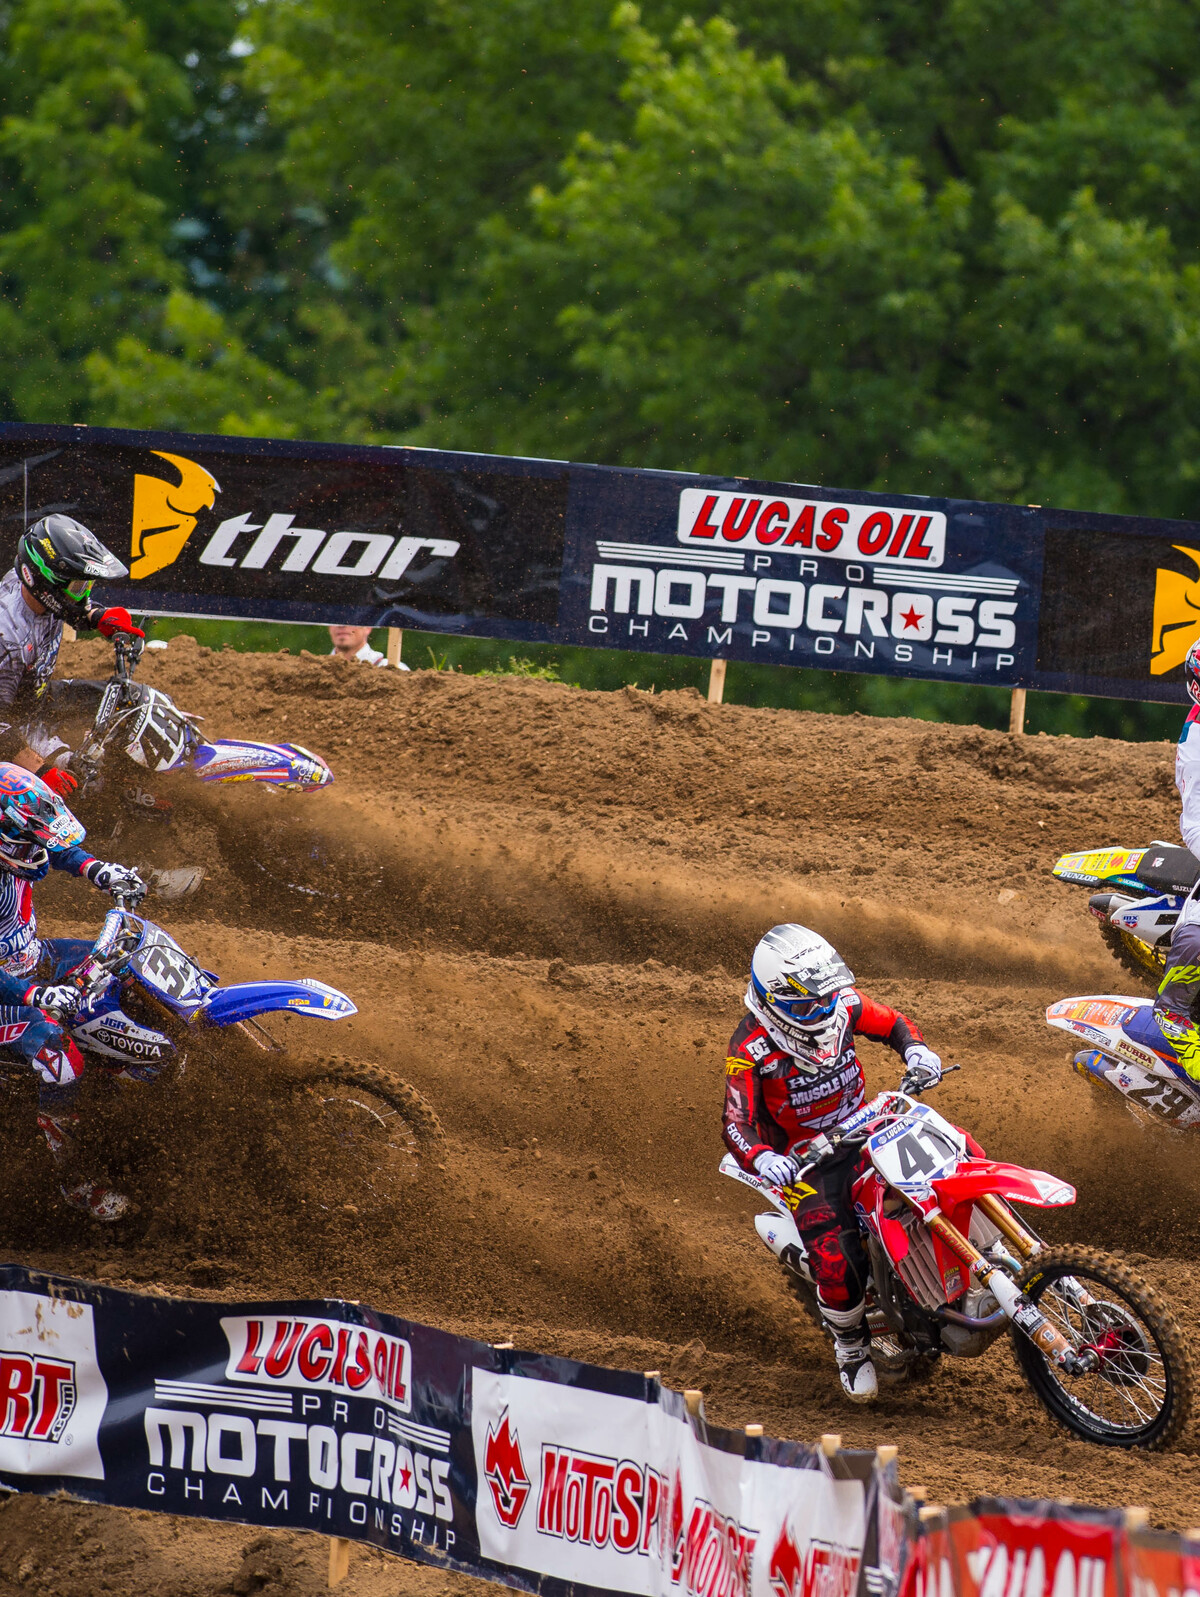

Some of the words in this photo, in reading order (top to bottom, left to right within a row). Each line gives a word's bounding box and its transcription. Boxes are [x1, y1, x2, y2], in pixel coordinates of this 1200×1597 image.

[690, 495, 849, 552] LUCAS
[857, 511, 934, 561] OIL
[200, 511, 460, 580] thor
[752, 555, 864, 583] PRO
[590, 563, 1018, 649] MOTOCROSS
[588, 616, 1015, 671] CHAMPIONSHIP
[1060, 871, 1098, 882] DUNLOP
[1172, 884, 1195, 893] SUZU
[100, 1017, 127, 1031] JGR
[111, 1034, 162, 1058] TOYOTA
[1119, 1041, 1152, 1064] BUBBA
[791, 1077, 842, 1107] MUSCLE
[885, 1120, 907, 1140] LUCAS
[896, 1119, 956, 1180] 41
[738, 1171, 762, 1188] DUNLOP
[1005, 1191, 1045, 1205] DUNLOP
[933, 1222, 974, 1270] SHOWA
[373, 1338, 407, 1402] OIL
[303, 1395, 385, 1430] PRO
[144, 1407, 454, 1522] MOTOCROSS
[147, 1472, 457, 1551] CHAMPIONSHIP
